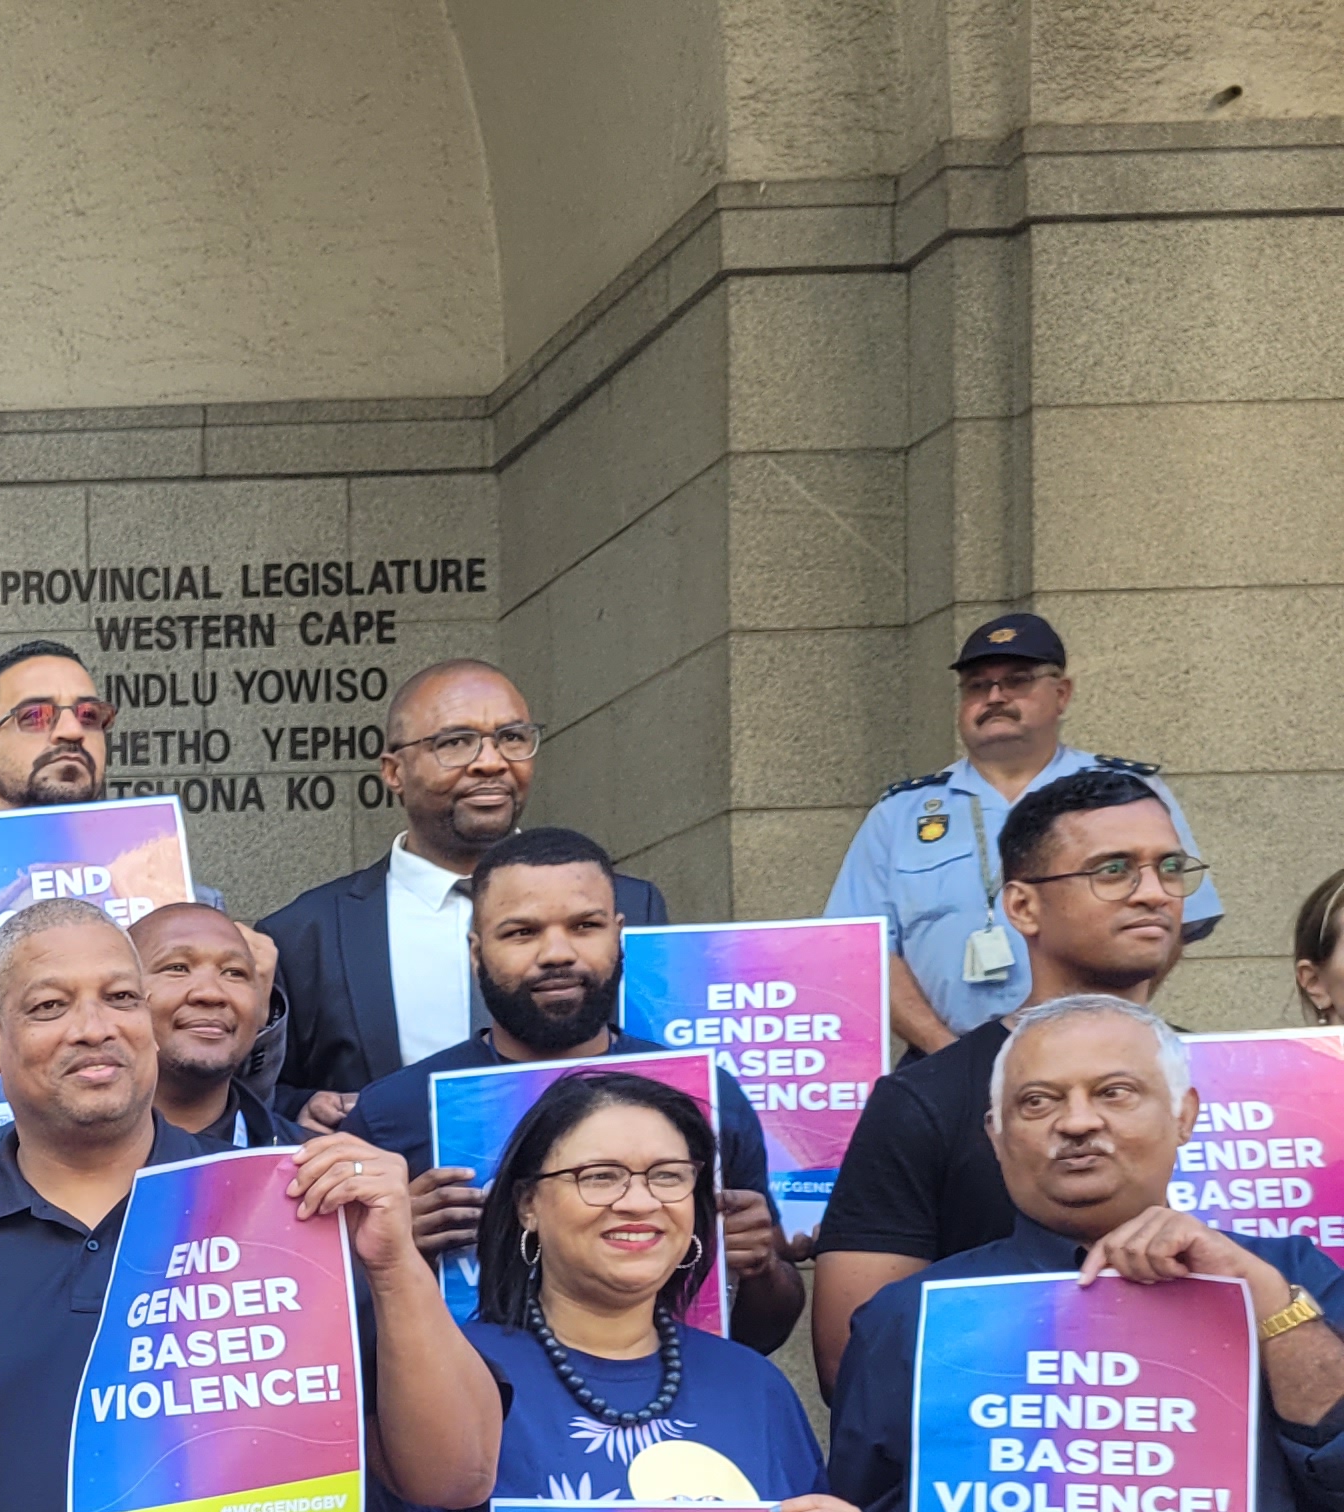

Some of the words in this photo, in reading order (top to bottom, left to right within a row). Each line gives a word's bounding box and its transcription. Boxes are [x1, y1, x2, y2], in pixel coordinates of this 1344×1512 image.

[0, 564, 223, 605] PROVINCIAL
[241, 558, 487, 599] LEGISLATURE
[95, 613, 275, 653] WESTERN
[300, 610, 397, 647] CAPE
[234, 667, 387, 705] YOWISO
[106, 729, 231, 766] HETHO
[263, 725, 384, 762] YEPHO
[30, 866, 112, 900] END
[707, 981, 797, 1010] END
[664, 1014, 842, 1046] GENDER
[716, 1048, 825, 1077] ASED
[1177, 1137, 1327, 1172] ENDER
[1166, 1177, 1313, 1212] BASED
[165, 1235, 241, 1279] END
[126, 1277, 302, 1328] GENDER
[127, 1324, 286, 1374] BASED
[1026, 1350, 1141, 1386] END
[89, 1363, 341, 1424] VIOLENCE!
[969, 1393, 1197, 1434] GENDER
[989, 1438, 1175, 1477] BASED
